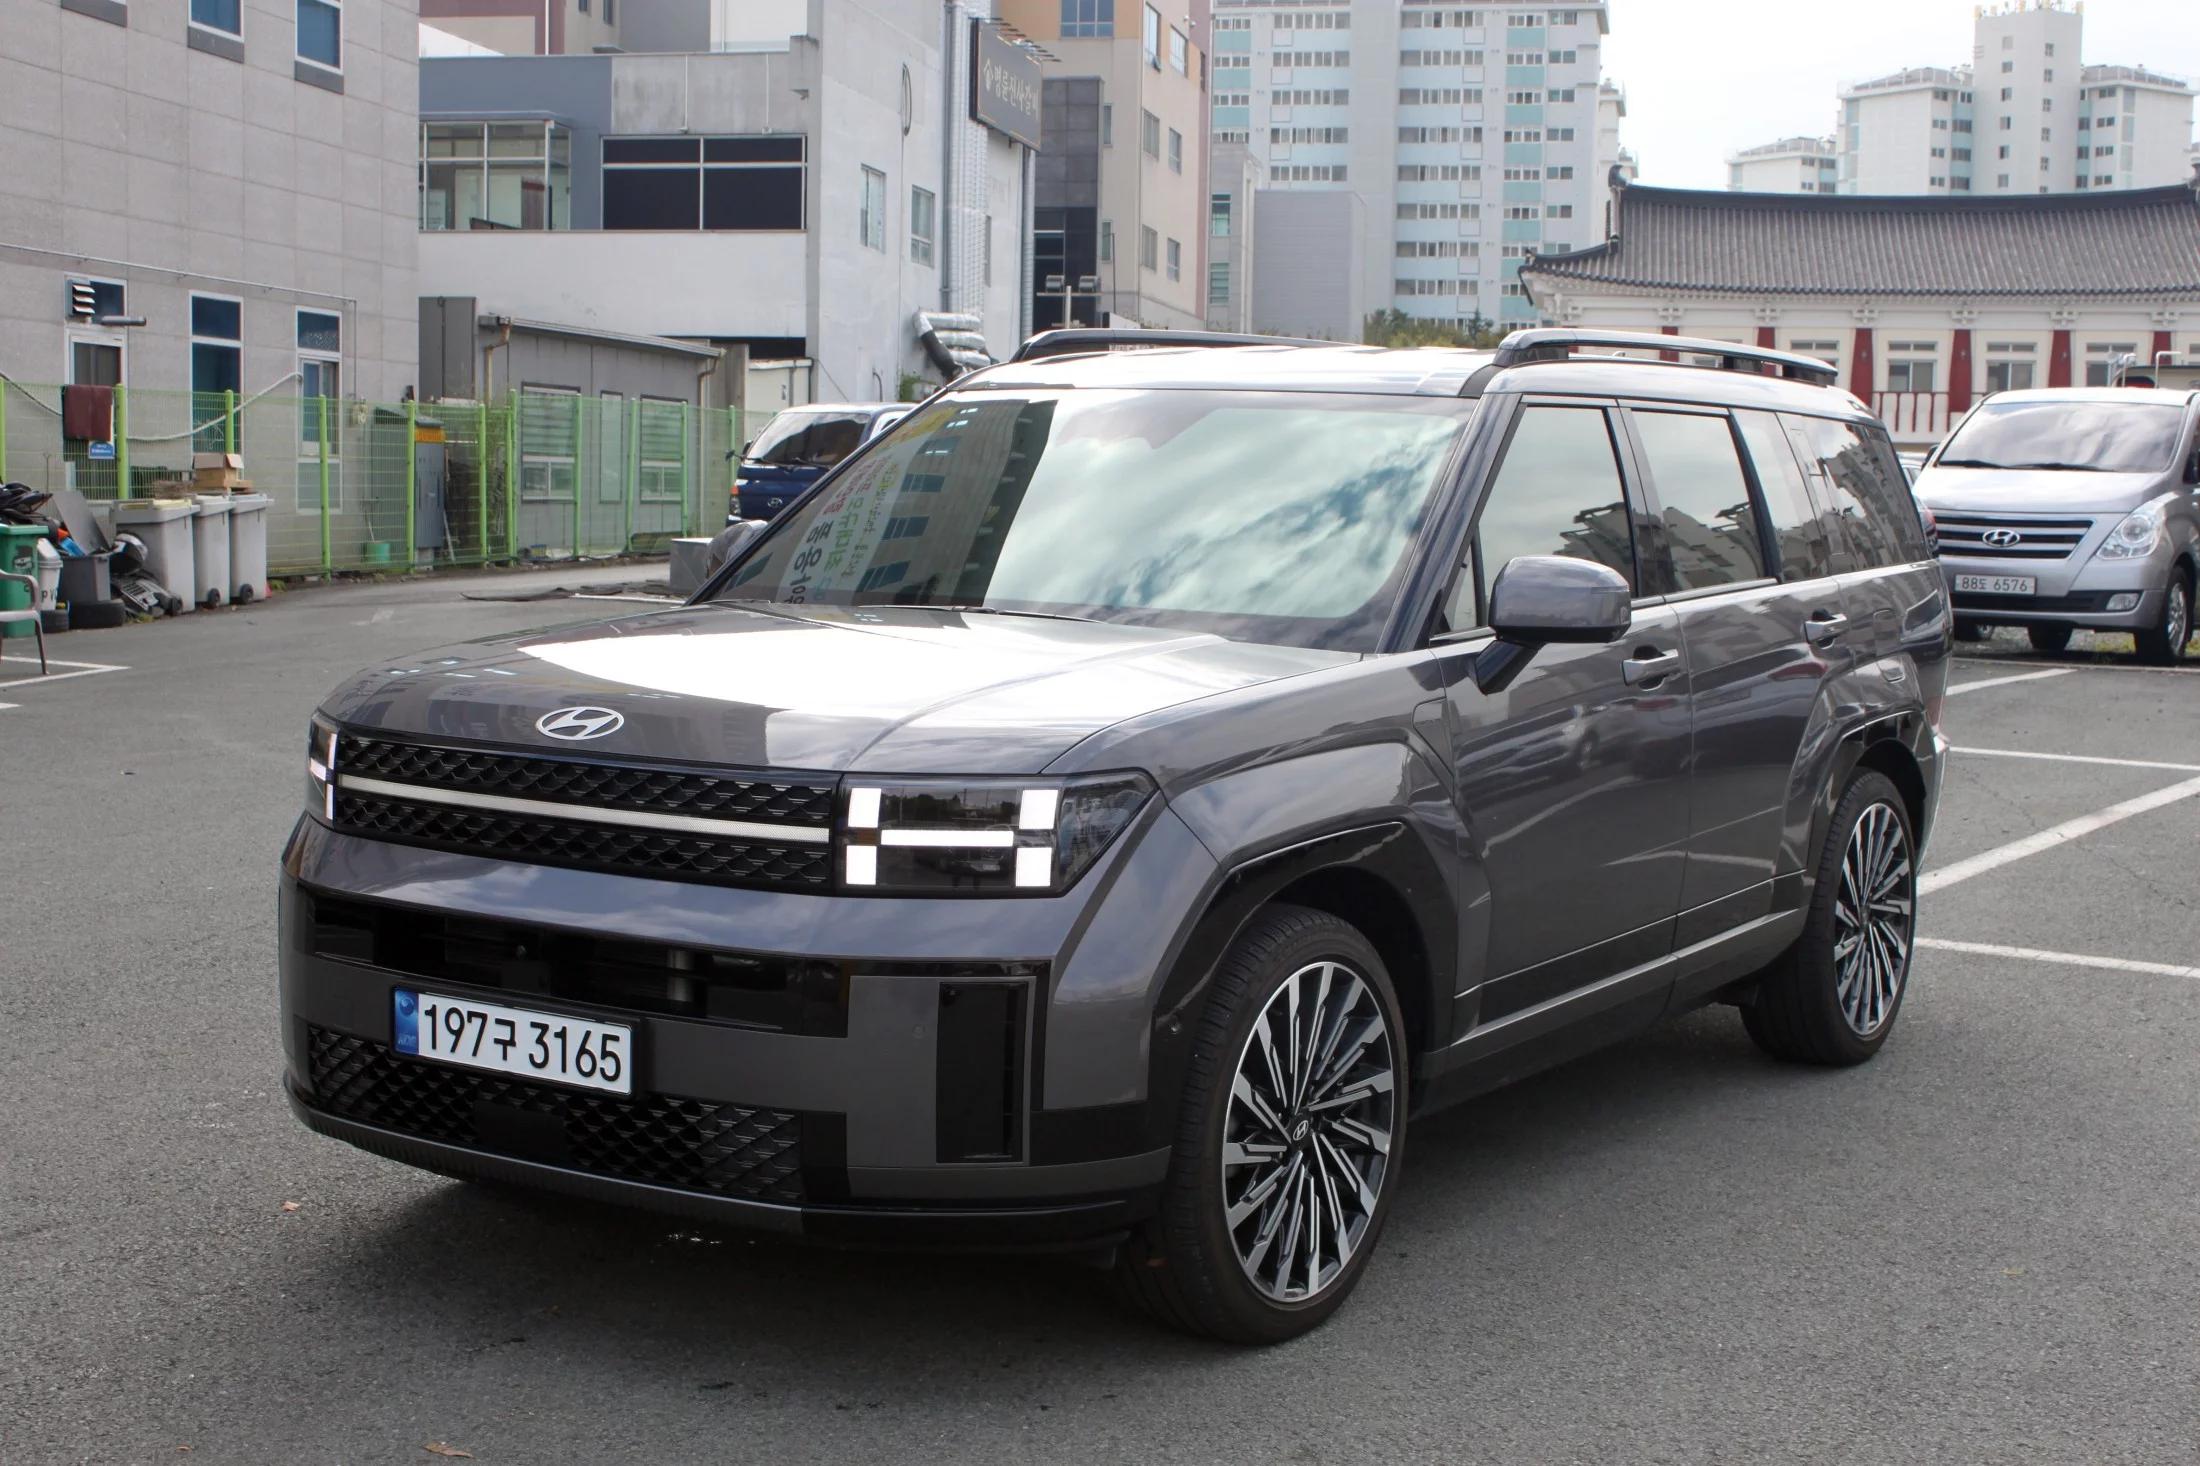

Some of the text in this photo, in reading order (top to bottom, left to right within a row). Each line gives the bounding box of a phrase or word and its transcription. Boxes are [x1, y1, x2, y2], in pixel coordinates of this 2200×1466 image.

[994, 64, 1039, 121] 명륜진사갈비
[1962, 577, 2028, 592] 88도 6576
[425, 1004, 621, 1082] 197구 3165
